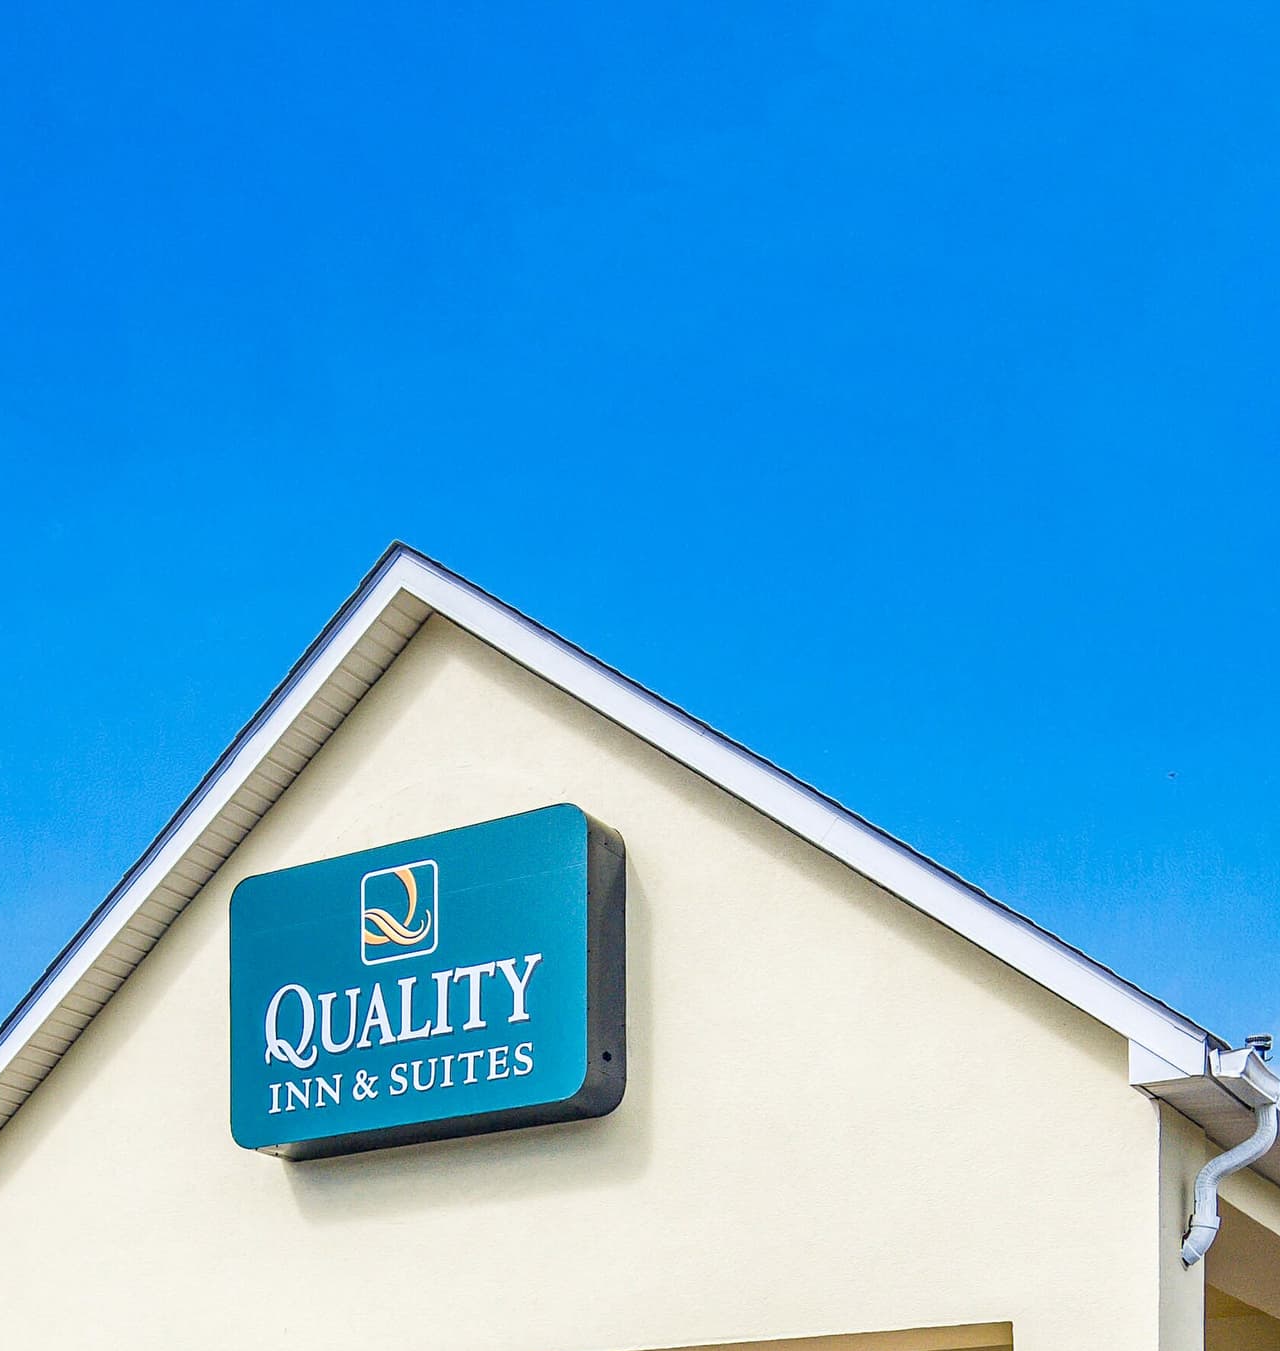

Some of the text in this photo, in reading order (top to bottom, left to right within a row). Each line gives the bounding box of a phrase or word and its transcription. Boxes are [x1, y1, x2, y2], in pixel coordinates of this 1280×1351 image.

[265, 953, 542, 1069] QUALITY
[268, 1042, 534, 1114] INN & SUITES
